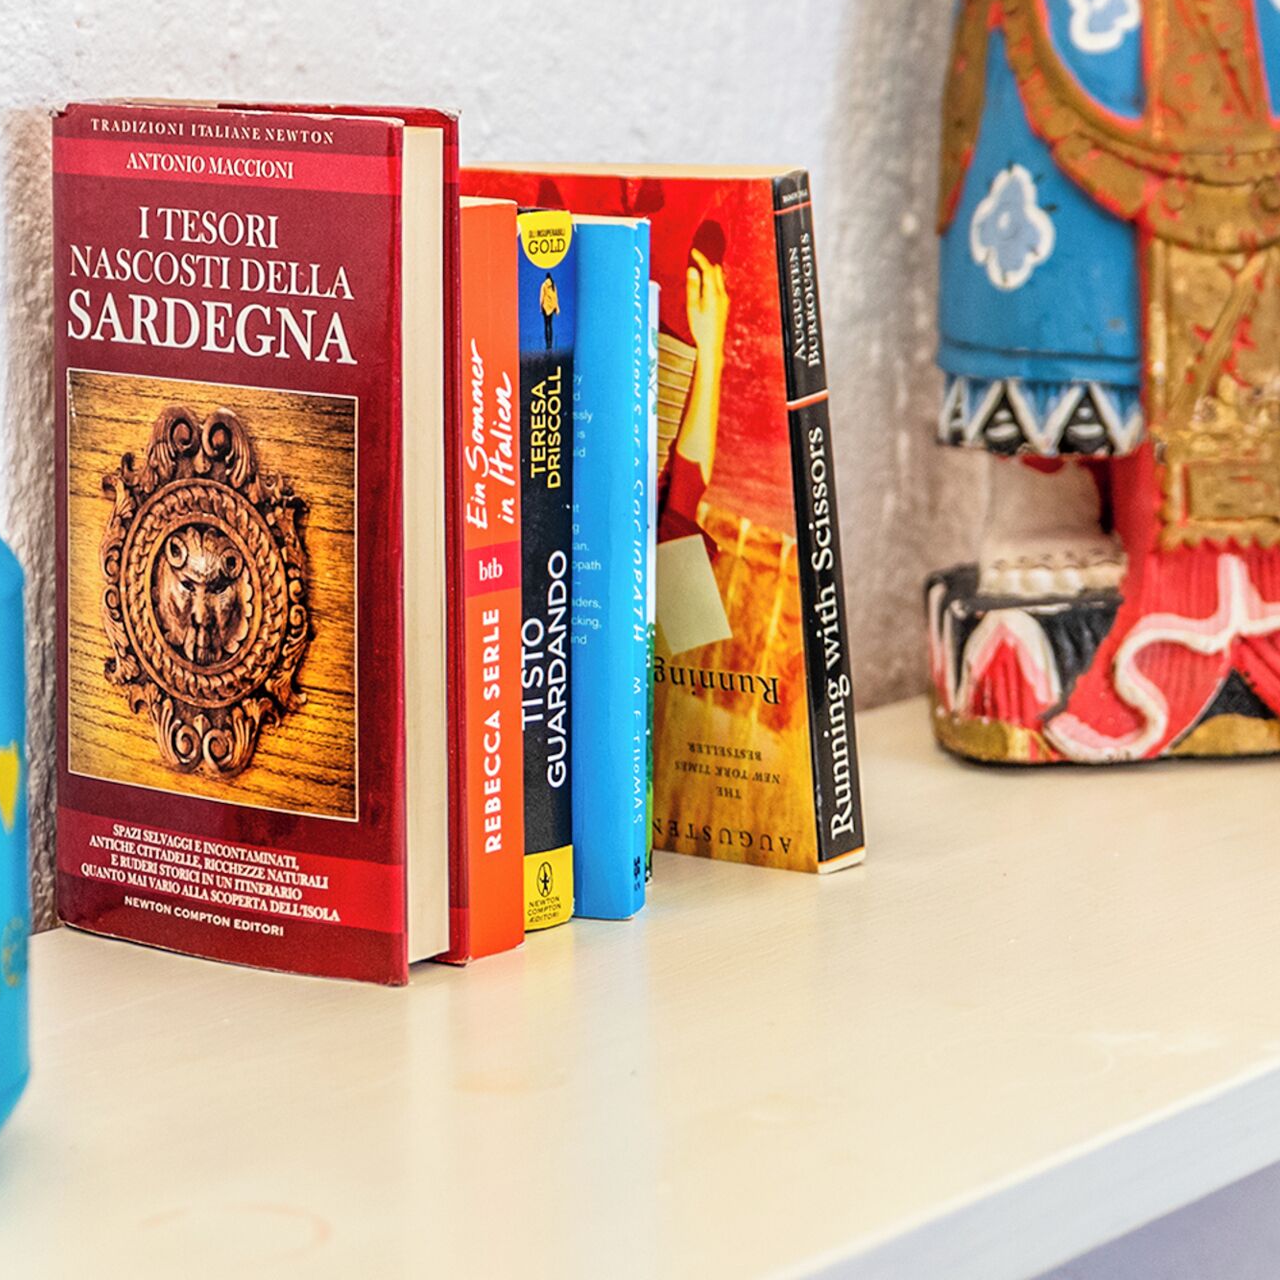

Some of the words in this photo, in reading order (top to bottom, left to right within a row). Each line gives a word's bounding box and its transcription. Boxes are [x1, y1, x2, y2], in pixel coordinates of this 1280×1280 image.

[90, 118, 184, 136] TRADIZIONI
[191, 123, 261, 140] ITALIANE
[265, 128, 334, 144] NEWTON
[126, 152, 206, 173] ANTONIO
[209, 157, 294, 179] MACCIONI
[138, 206, 150, 239] I
[157, 208, 279, 249] TESORI
[528, 238, 566, 255] GOLD
[70, 244, 231, 290] NASCOSTI
[240, 257, 355, 300] DELLA
[788, 247, 807, 361] AUGUSTEN
[799, 232, 821, 368] BURROUGHS
[67, 288, 358, 365] SARDEGNA
[464, 338, 489, 478] Sommer
[488, 371, 516, 487] Italien
[530, 380, 547, 479] TERESA
[547, 365, 562, 489] DRISCOLL
[465, 483, 488, 530] Ein
[497, 497, 516, 525] in
[808, 425, 835, 571] Scissors
[479, 557, 503, 582] btb
[816, 581, 844, 671] with
[482, 608, 501, 699] SERLE
[520, 617, 545, 689] STO
[546, 549, 568, 789] GUARDANDO
[654, 656, 781, 705] Running
[521, 698, 544, 732] TI
[674, 760, 711, 776] TIMES
[686, 741, 763, 762] BESTSELLER
[715, 765, 748, 780] YORK
[824, 672, 855, 841] Running
[483, 709, 502, 854] REBECCA
[716, 786, 742, 800] THE
[752, 771, 781, 785] NEW
[89, 835, 136, 855] ANTICHE
[136, 844, 202, 869] CITTADELLE,
[204, 857, 266, 880] RICCHEZZE
[267, 868, 329, 890] NATURALI
[112, 823, 141, 840] SPAZI
[143, 829, 193, 851] SELVAGGI
[194, 840, 202, 852] E
[203, 841, 299, 871] INCONTAMINATI,
[81, 863, 126, 882] QUANTO
[127, 872, 148, 888] MAI
[148, 876, 181, 894] VARIO
[181, 884, 209, 901] ALLA
[210, 889, 268, 912] SCOPERTA
[270, 900, 341, 922] DELL'ISOLA
[110, 853, 119, 866] E
[119, 855, 158, 874] RUDERI
[159, 863, 200, 883] STORICI
[201, 872, 214, 885] IN
[216, 875, 232, 889] UN
[234, 878, 303, 901] ITINERARIO
[124, 895, 172, 915] NEWTON
[174, 906, 231, 928] COMPTON
[233, 918, 284, 936] EDITORI
[527, 903, 562, 917] COMPTON
[528, 895, 561, 908] NEWTON
